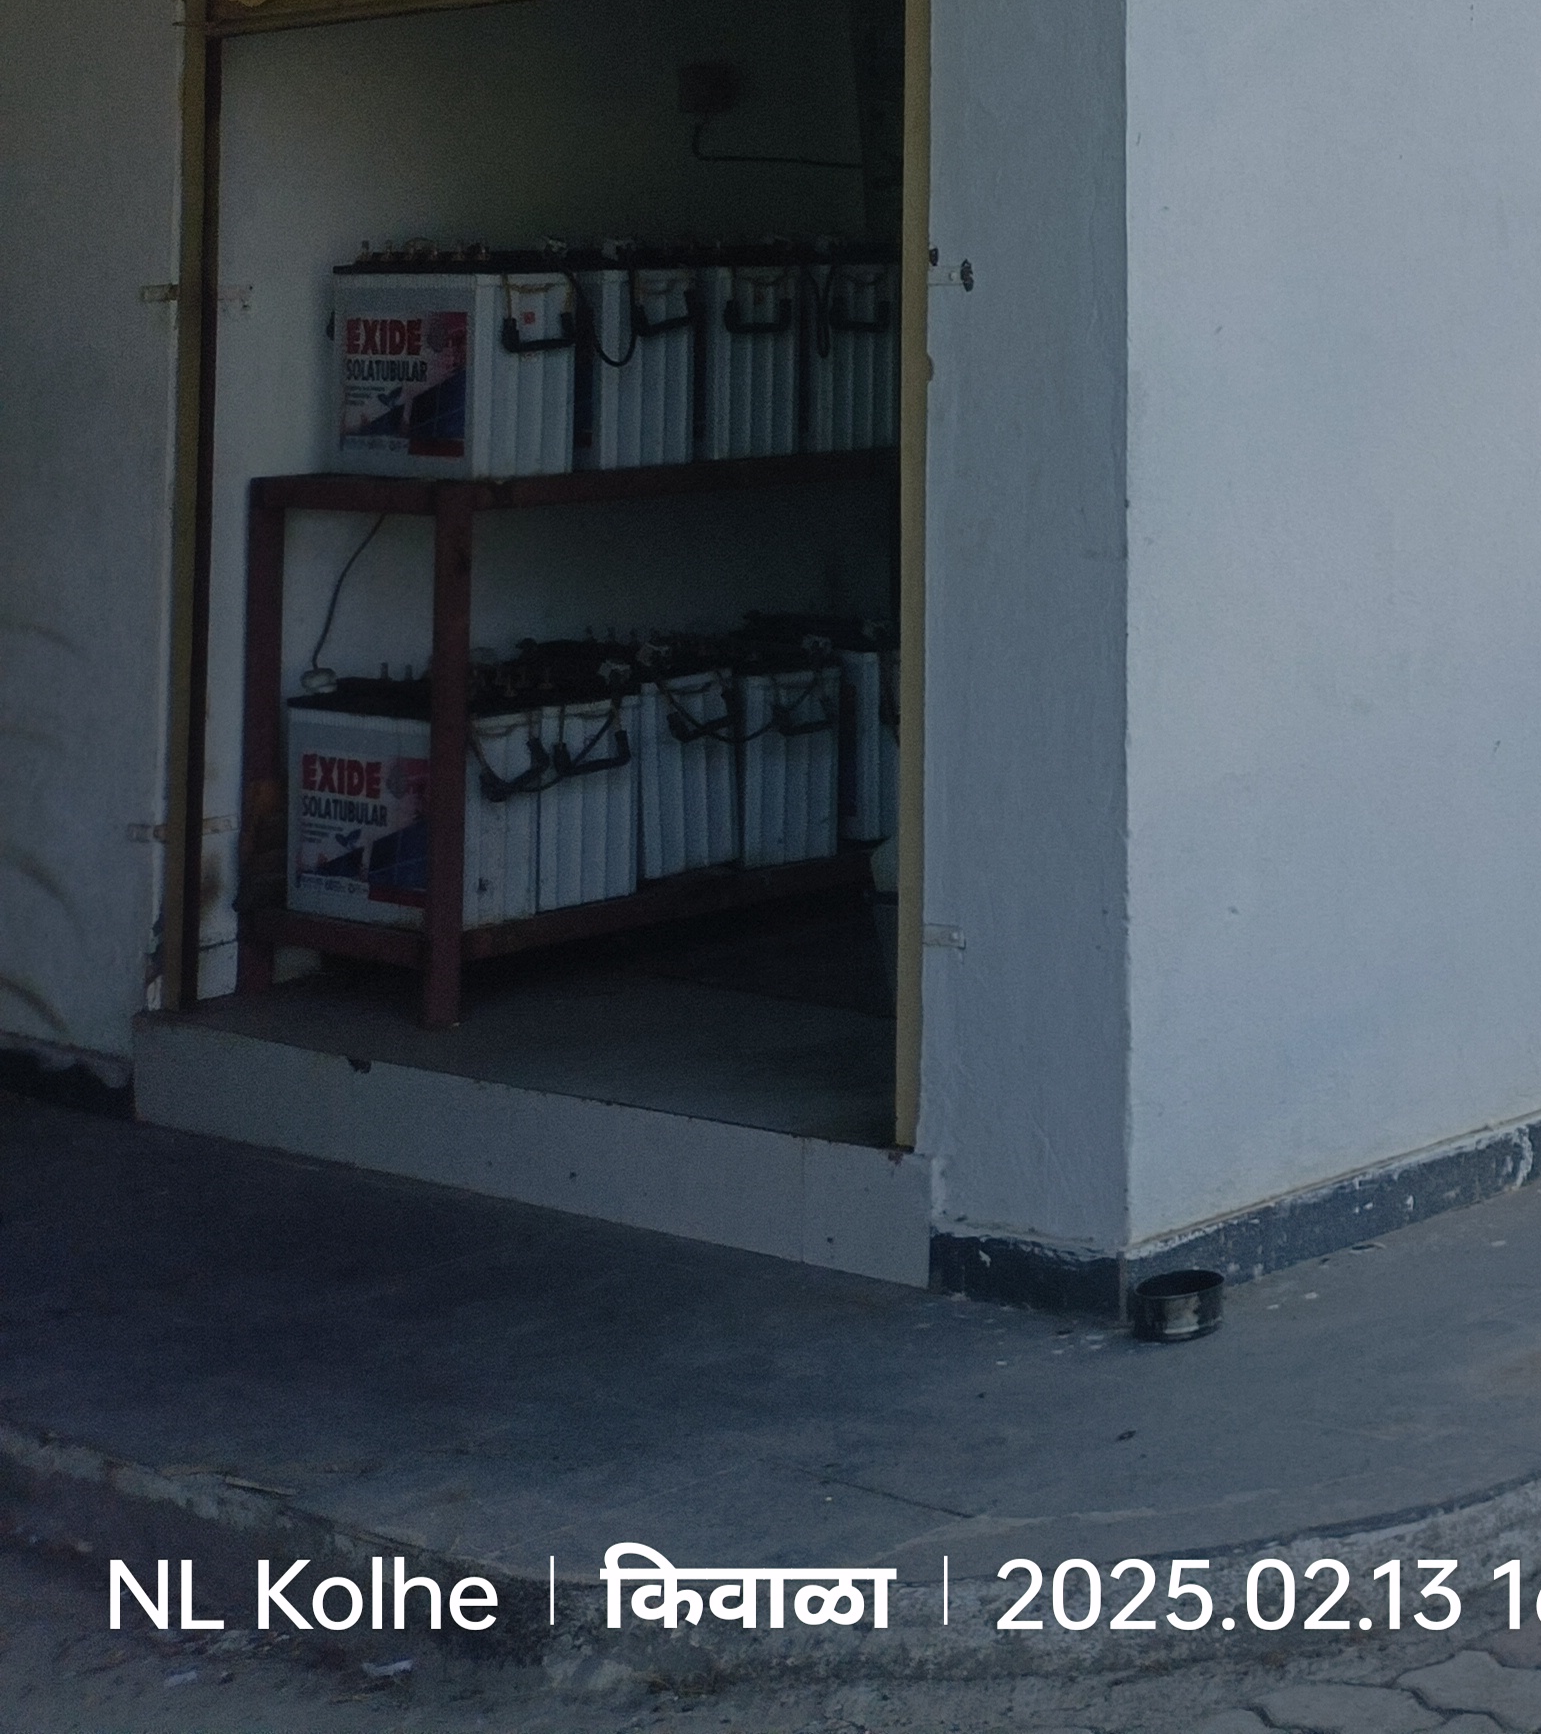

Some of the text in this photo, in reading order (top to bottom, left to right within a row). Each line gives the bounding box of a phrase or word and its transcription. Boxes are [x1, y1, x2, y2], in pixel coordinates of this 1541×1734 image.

[346, 318, 422, 355] EXIDE
[346, 358, 427, 382] SOLATUBULAR
[302, 753, 382, 799] EXIDE
[302, 795, 388, 827] SOLATUBULAR
